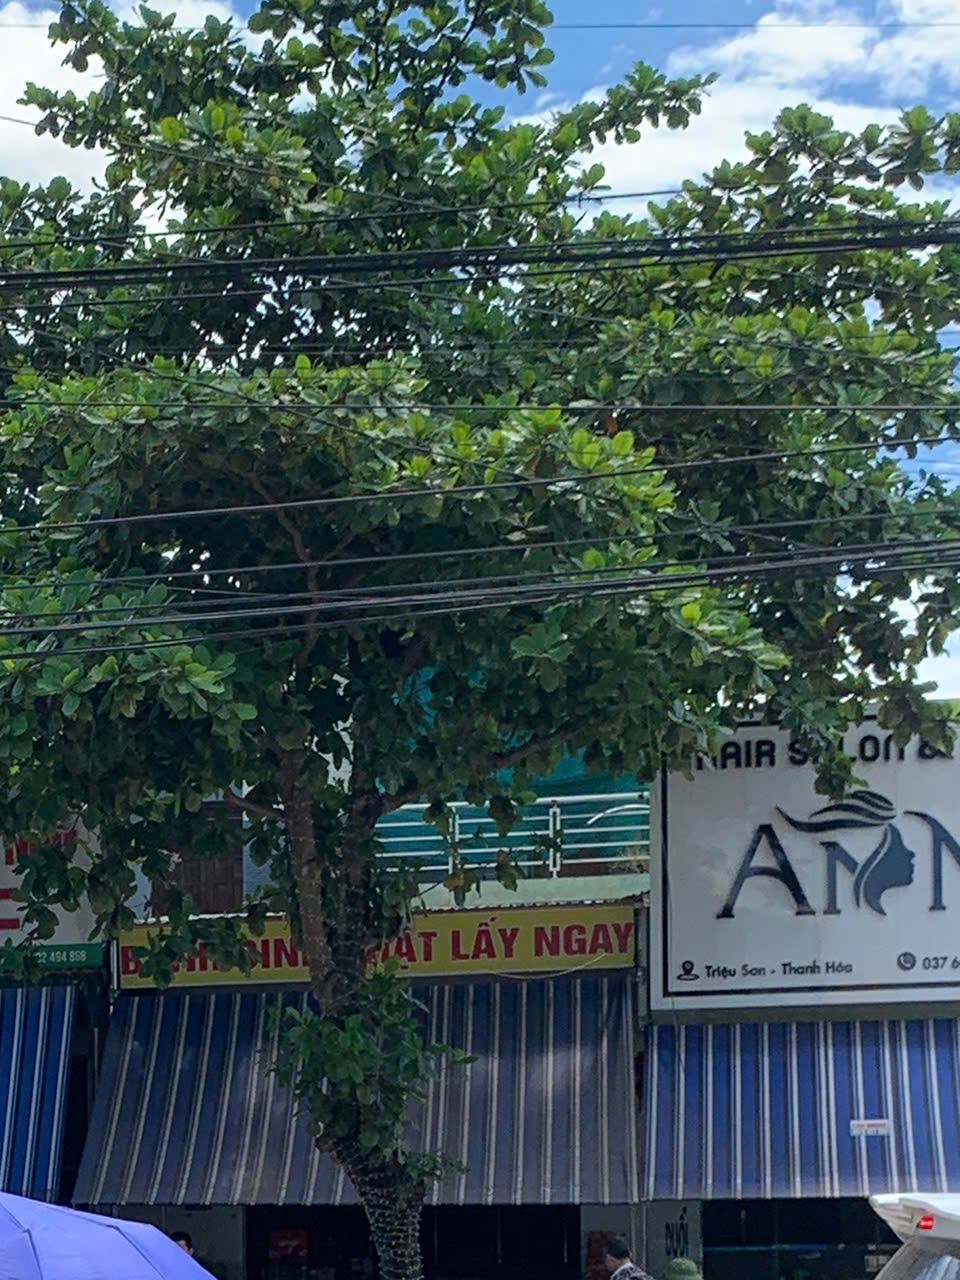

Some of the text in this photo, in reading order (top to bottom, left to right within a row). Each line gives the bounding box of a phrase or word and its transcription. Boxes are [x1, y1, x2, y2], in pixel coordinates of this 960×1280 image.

[451, 916, 520, 960] LẤY
[534, 922, 633, 957] NGAY
[781, 960, 821, 976] Thanh
[922, 956, 947, 970] 037
